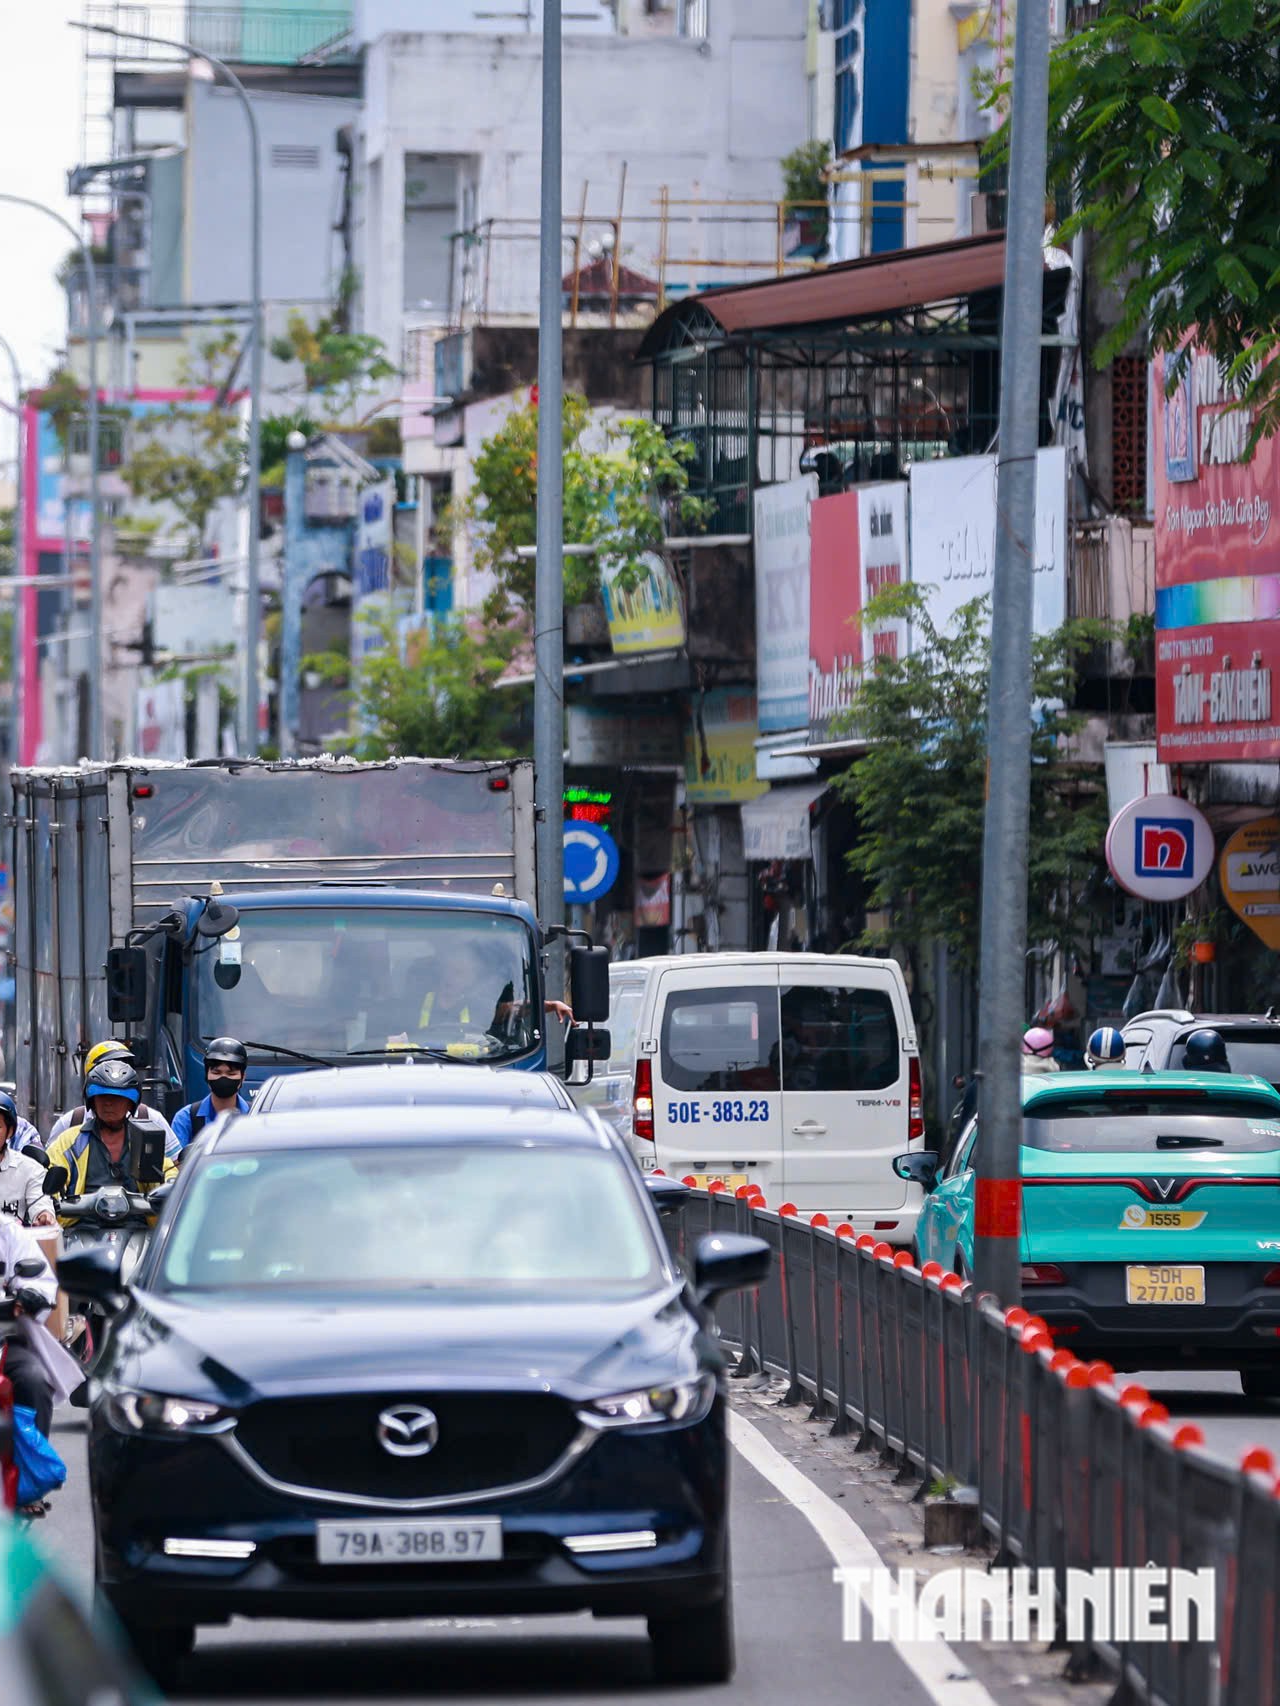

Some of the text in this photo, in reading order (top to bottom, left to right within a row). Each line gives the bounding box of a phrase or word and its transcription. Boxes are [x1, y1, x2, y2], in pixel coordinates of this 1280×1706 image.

[1149, 1213, 1181, 1226] 1555
[1149, 1269, 1182, 1284] 50H
[1137, 1286, 1196, 1301] 277.08
